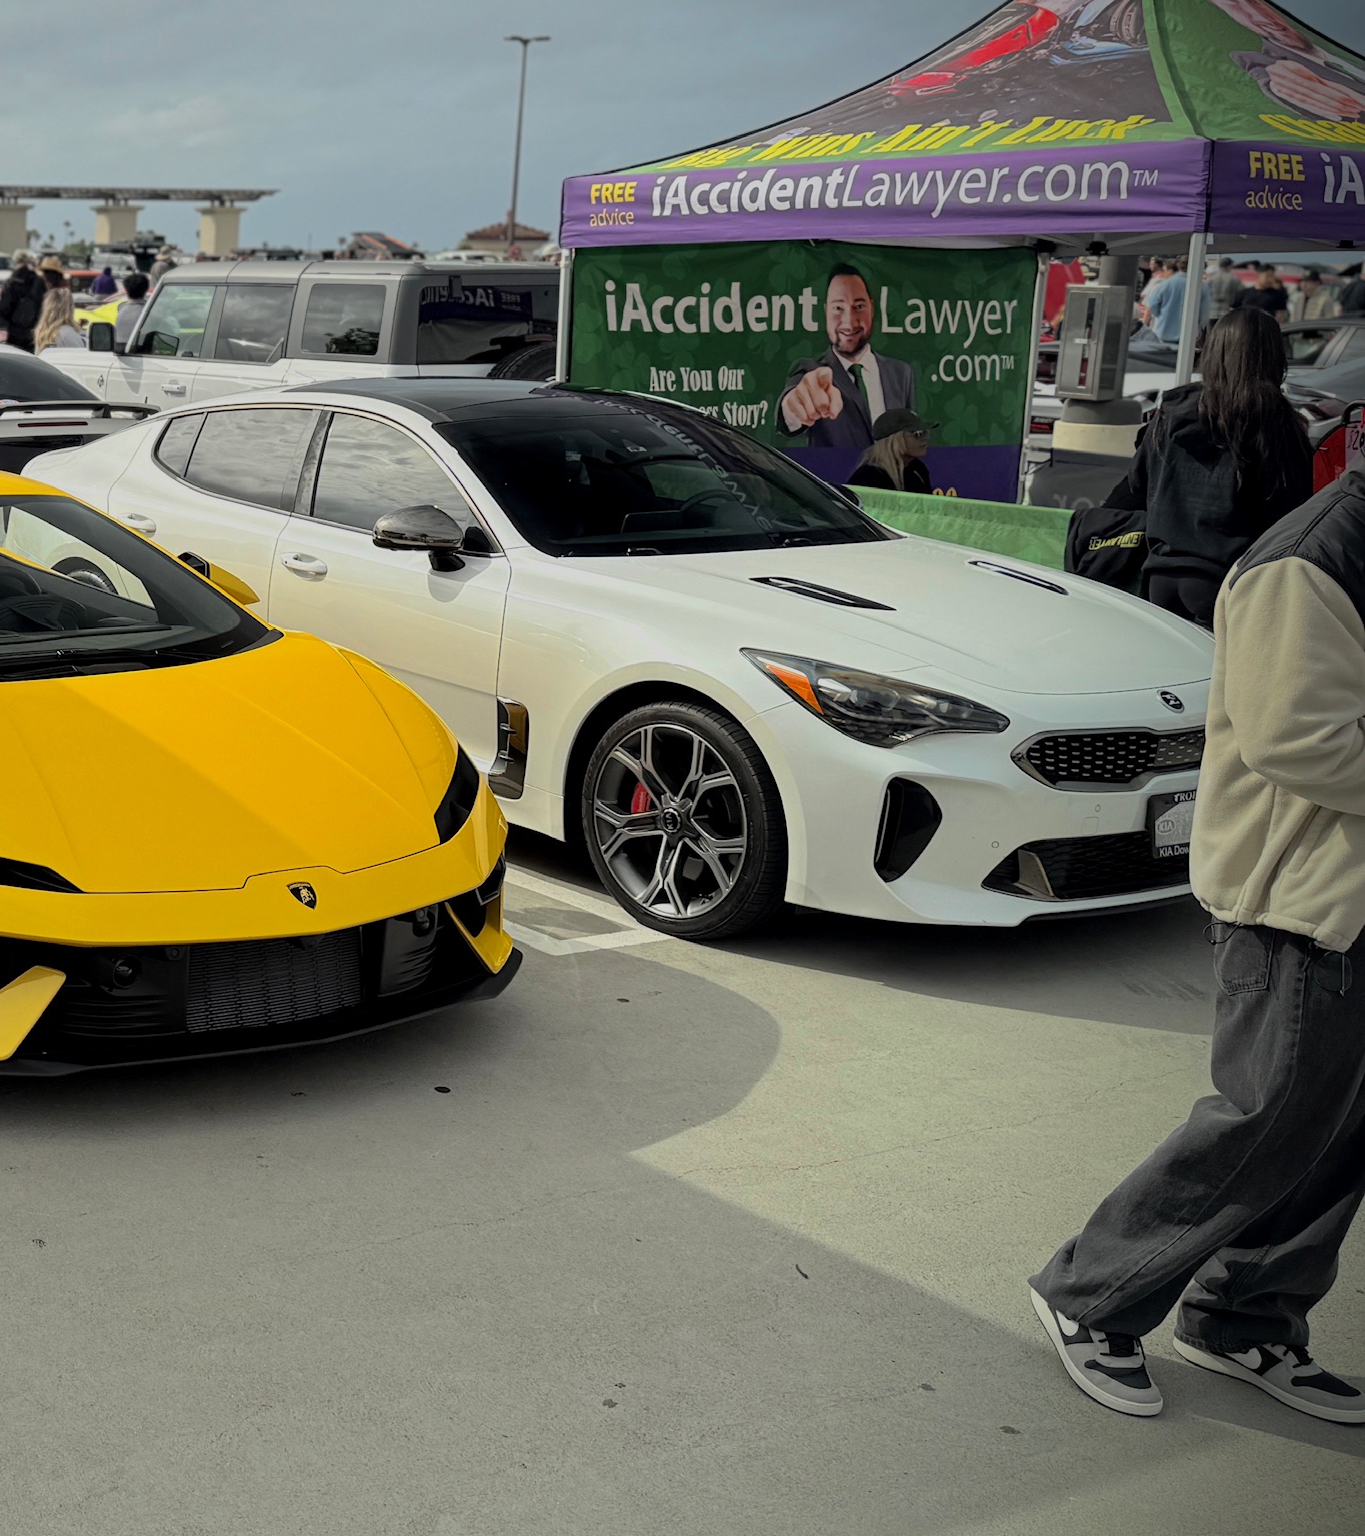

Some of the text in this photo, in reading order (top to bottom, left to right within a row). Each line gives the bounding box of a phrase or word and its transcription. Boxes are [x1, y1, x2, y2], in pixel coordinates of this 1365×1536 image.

[748, 131, 877, 161] Wins
[992, 114, 1155, 146] Luck
[1249, 151, 1306, 182] FREE
[590, 181, 637, 205] FREE
[1245, 185, 1303, 210] advice
[589, 208, 635, 227] advice
[604, 279, 1018, 349] iAccident Lawyer
[649, 365, 745, 392] Are You Our
[722, 400, 768, 429] Story?
[1159, 847, 1173, 857] KIA
